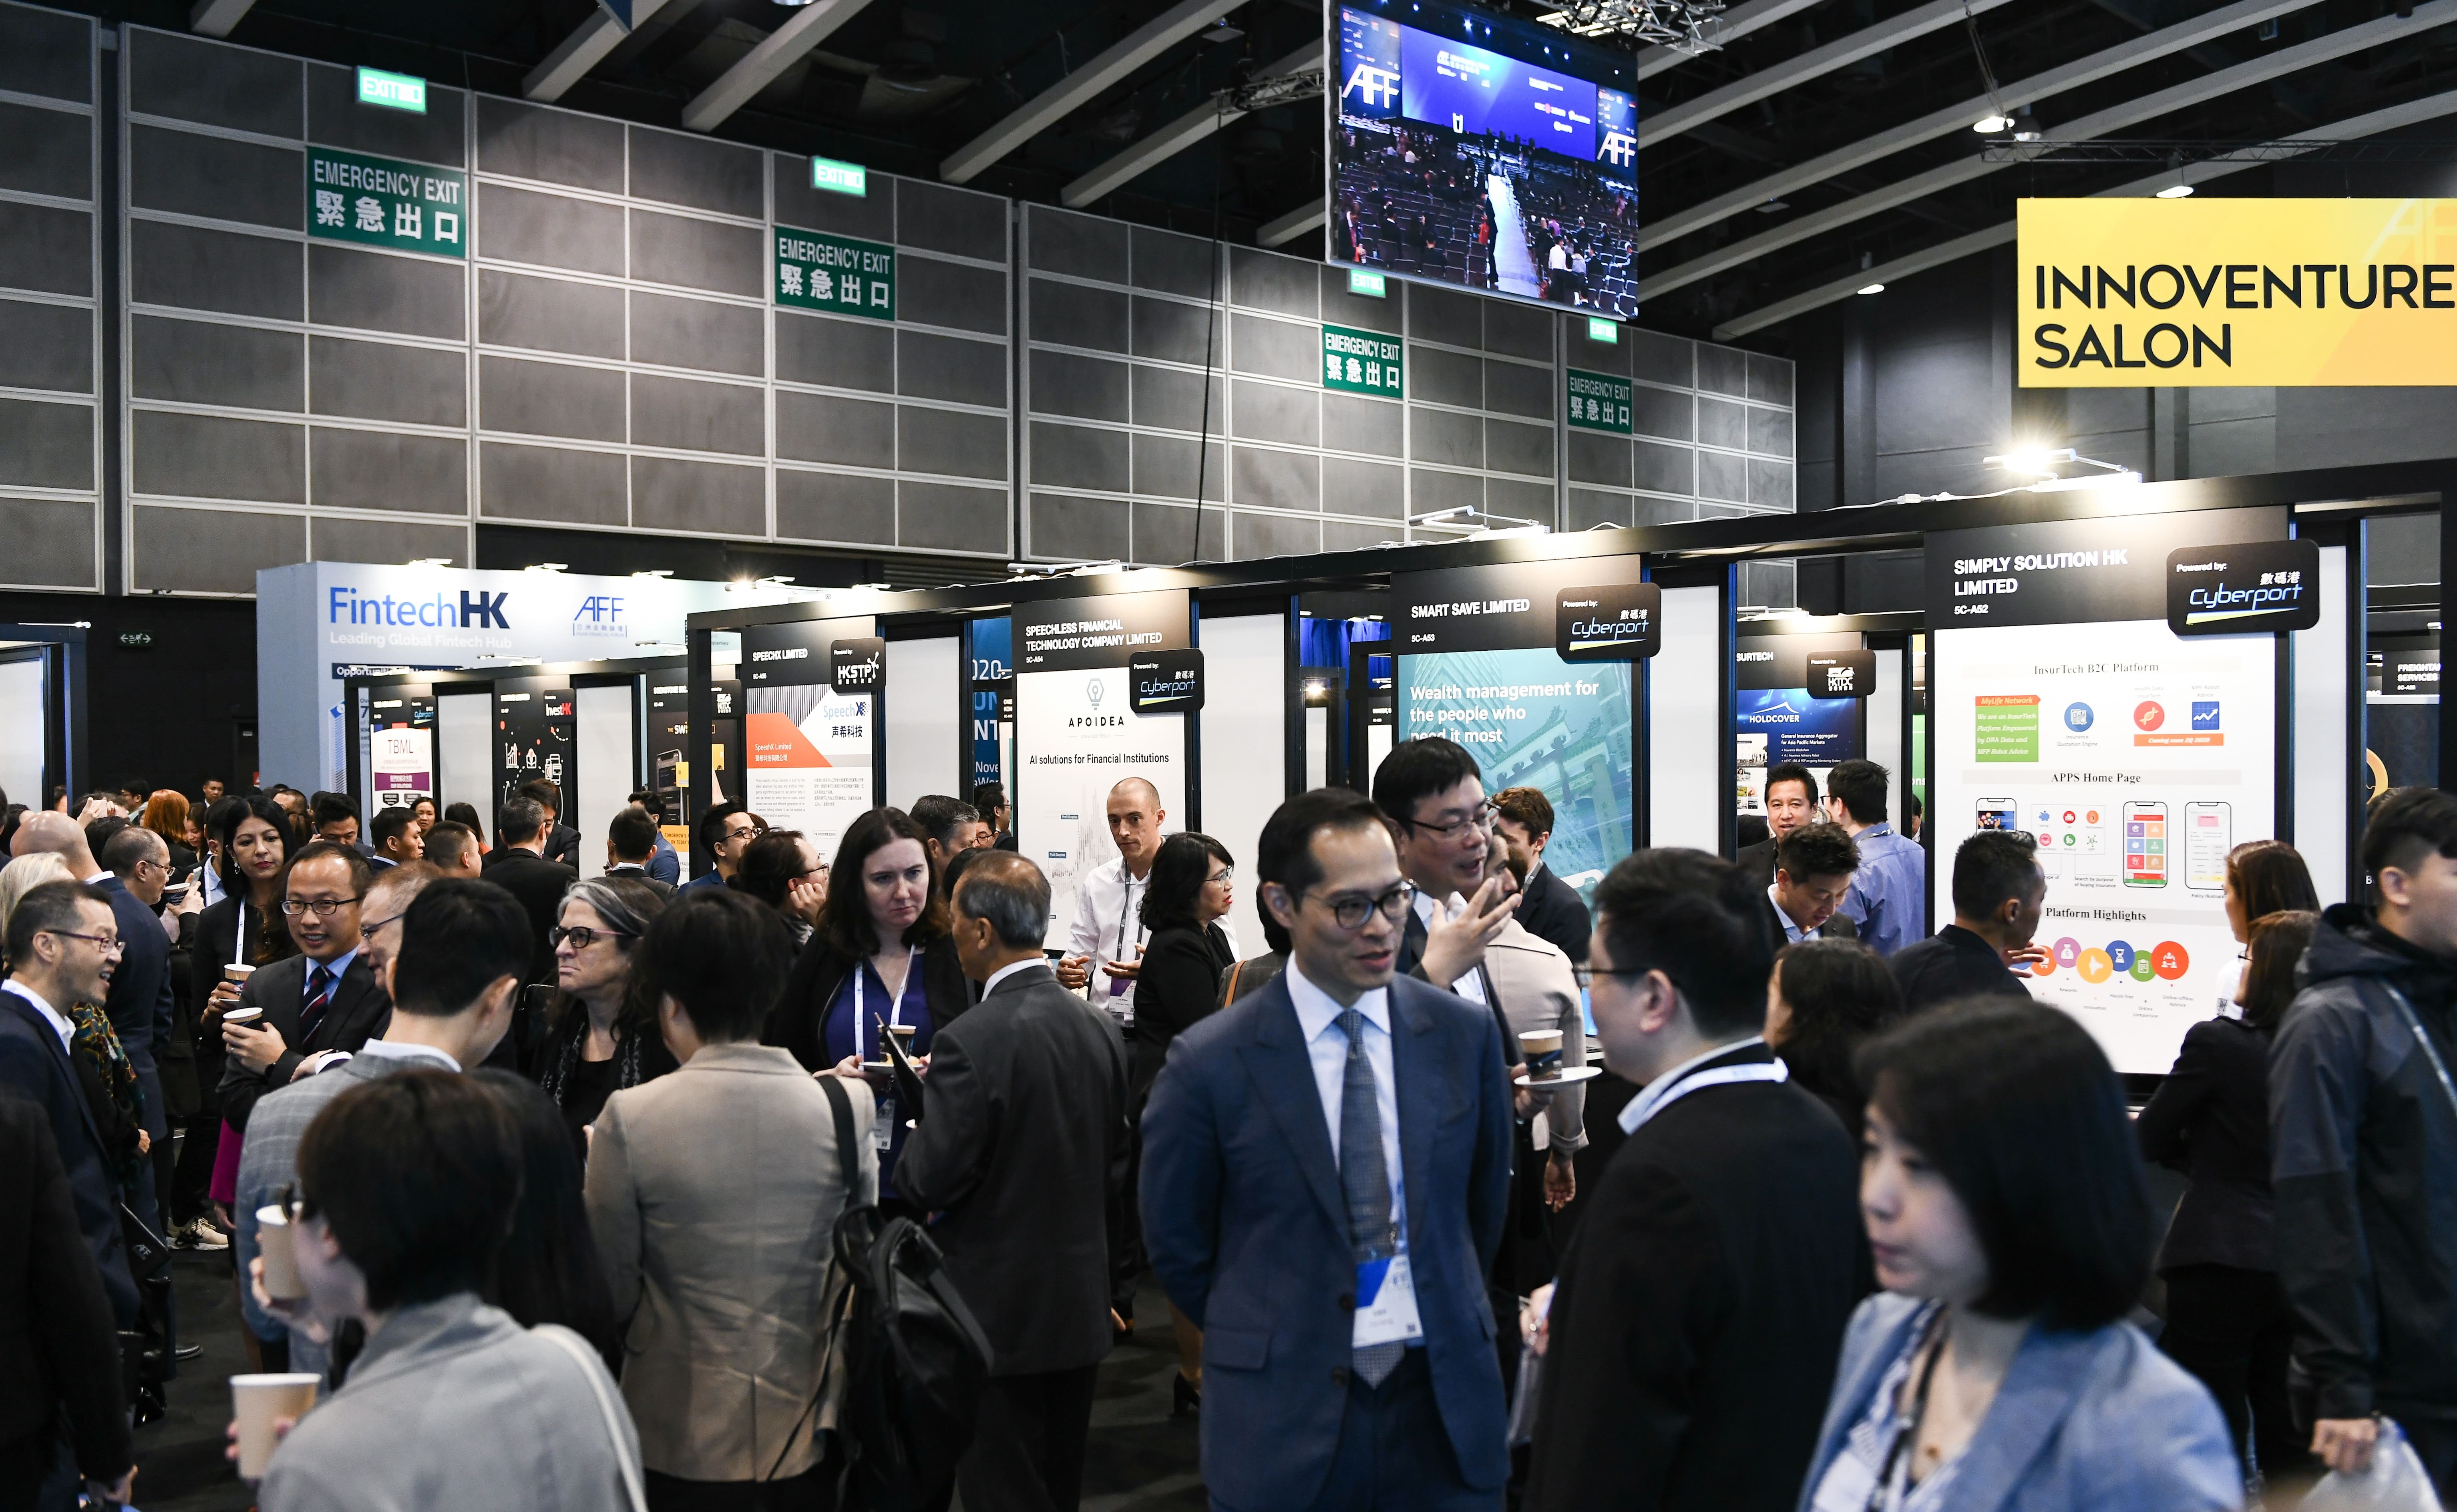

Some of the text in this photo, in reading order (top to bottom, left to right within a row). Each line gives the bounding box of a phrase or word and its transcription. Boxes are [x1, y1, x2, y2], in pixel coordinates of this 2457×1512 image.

[363, 76, 398, 99] EXIT
[1342, 63, 1401, 109] AFF
[1597, 131, 1637, 167] AFF
[314, 159, 460, 205] EMERGENCY EXIT
[817, 165, 844, 185] EXIT
[316, 189, 459, 243] 緊急出口
[779, 237, 890, 275] EMERGENCY EXIT
[780, 263, 889, 309] 緊急出口
[2037, 264, 2455, 309] INNOVENTURE
[1325, 333, 1399, 361] EMERGENCY EXIT
[2035, 323, 2232, 368] SALON
[1326, 354, 1399, 389] 緊急出口
[1570, 377, 1629, 401] EMERGENCY EXIT
[1571, 396, 1629, 426] 緊急出口
[1954, 549, 2128, 575] SIMPLY SOLUTION HK
[2176, 562, 2227, 572] Powered by:
[1954, 578, 2018, 596] LIMITED
[2260, 571, 2300, 585] 數碼港
[2190, 583, 2303, 610] Cyberport
[330, 587, 510, 629] FintechHK
[574, 596, 624, 622] AFF
[1411, 599, 1530, 618] SMART SAVE LIMITED
[1620, 609, 1648, 620] 數碼港
[1954, 604, 1989, 615] 5C-A52
[1026, 619, 1123, 637] SPEECHLESS FINANCIAL
[1572, 617, 1649, 641] Cyberport
[330, 631, 512, 649] Leading Global Fintech Hub
[1026, 632, 1162, 651] TECHNOLOGY COMPANY LIMITED
[1411, 634, 1435, 643] 5C-A53
[752, 648, 808, 662] SPEECHX LIMITED
[1736, 651, 1773, 662] SURTECH
[838, 664, 872, 679] HKSTP
[1175, 670, 1194, 680] 數碼港
[2035, 662, 2159, 675] InsurTech B2C Platform
[1141, 677, 1195, 697] Cyberport
[1828, 677, 1853, 686] HKTDC
[2397, 674, 2438, 682] SERVICES
[1410, 680, 1599, 701] Wealth management for
[823, 702, 866, 720] SpeechX
[1410, 705, 1526, 725] the people who
[1749, 714, 1800, 723] HOLDCOVER
[1069, 716, 1124, 728] APOIDEA
[832, 725, 863, 738] 声希科技
[1450, 728, 1461, 743] it
[1464, 728, 1503, 743] most
[388, 740, 414, 754] TBML
[976, 762, 998, 773] Nove
[1030, 753, 1169, 764] AI solutions for Financial Institutions
[2051, 773, 2141, 784] APPS Home Page
[2046, 908, 2147, 921] Platform Highlights
